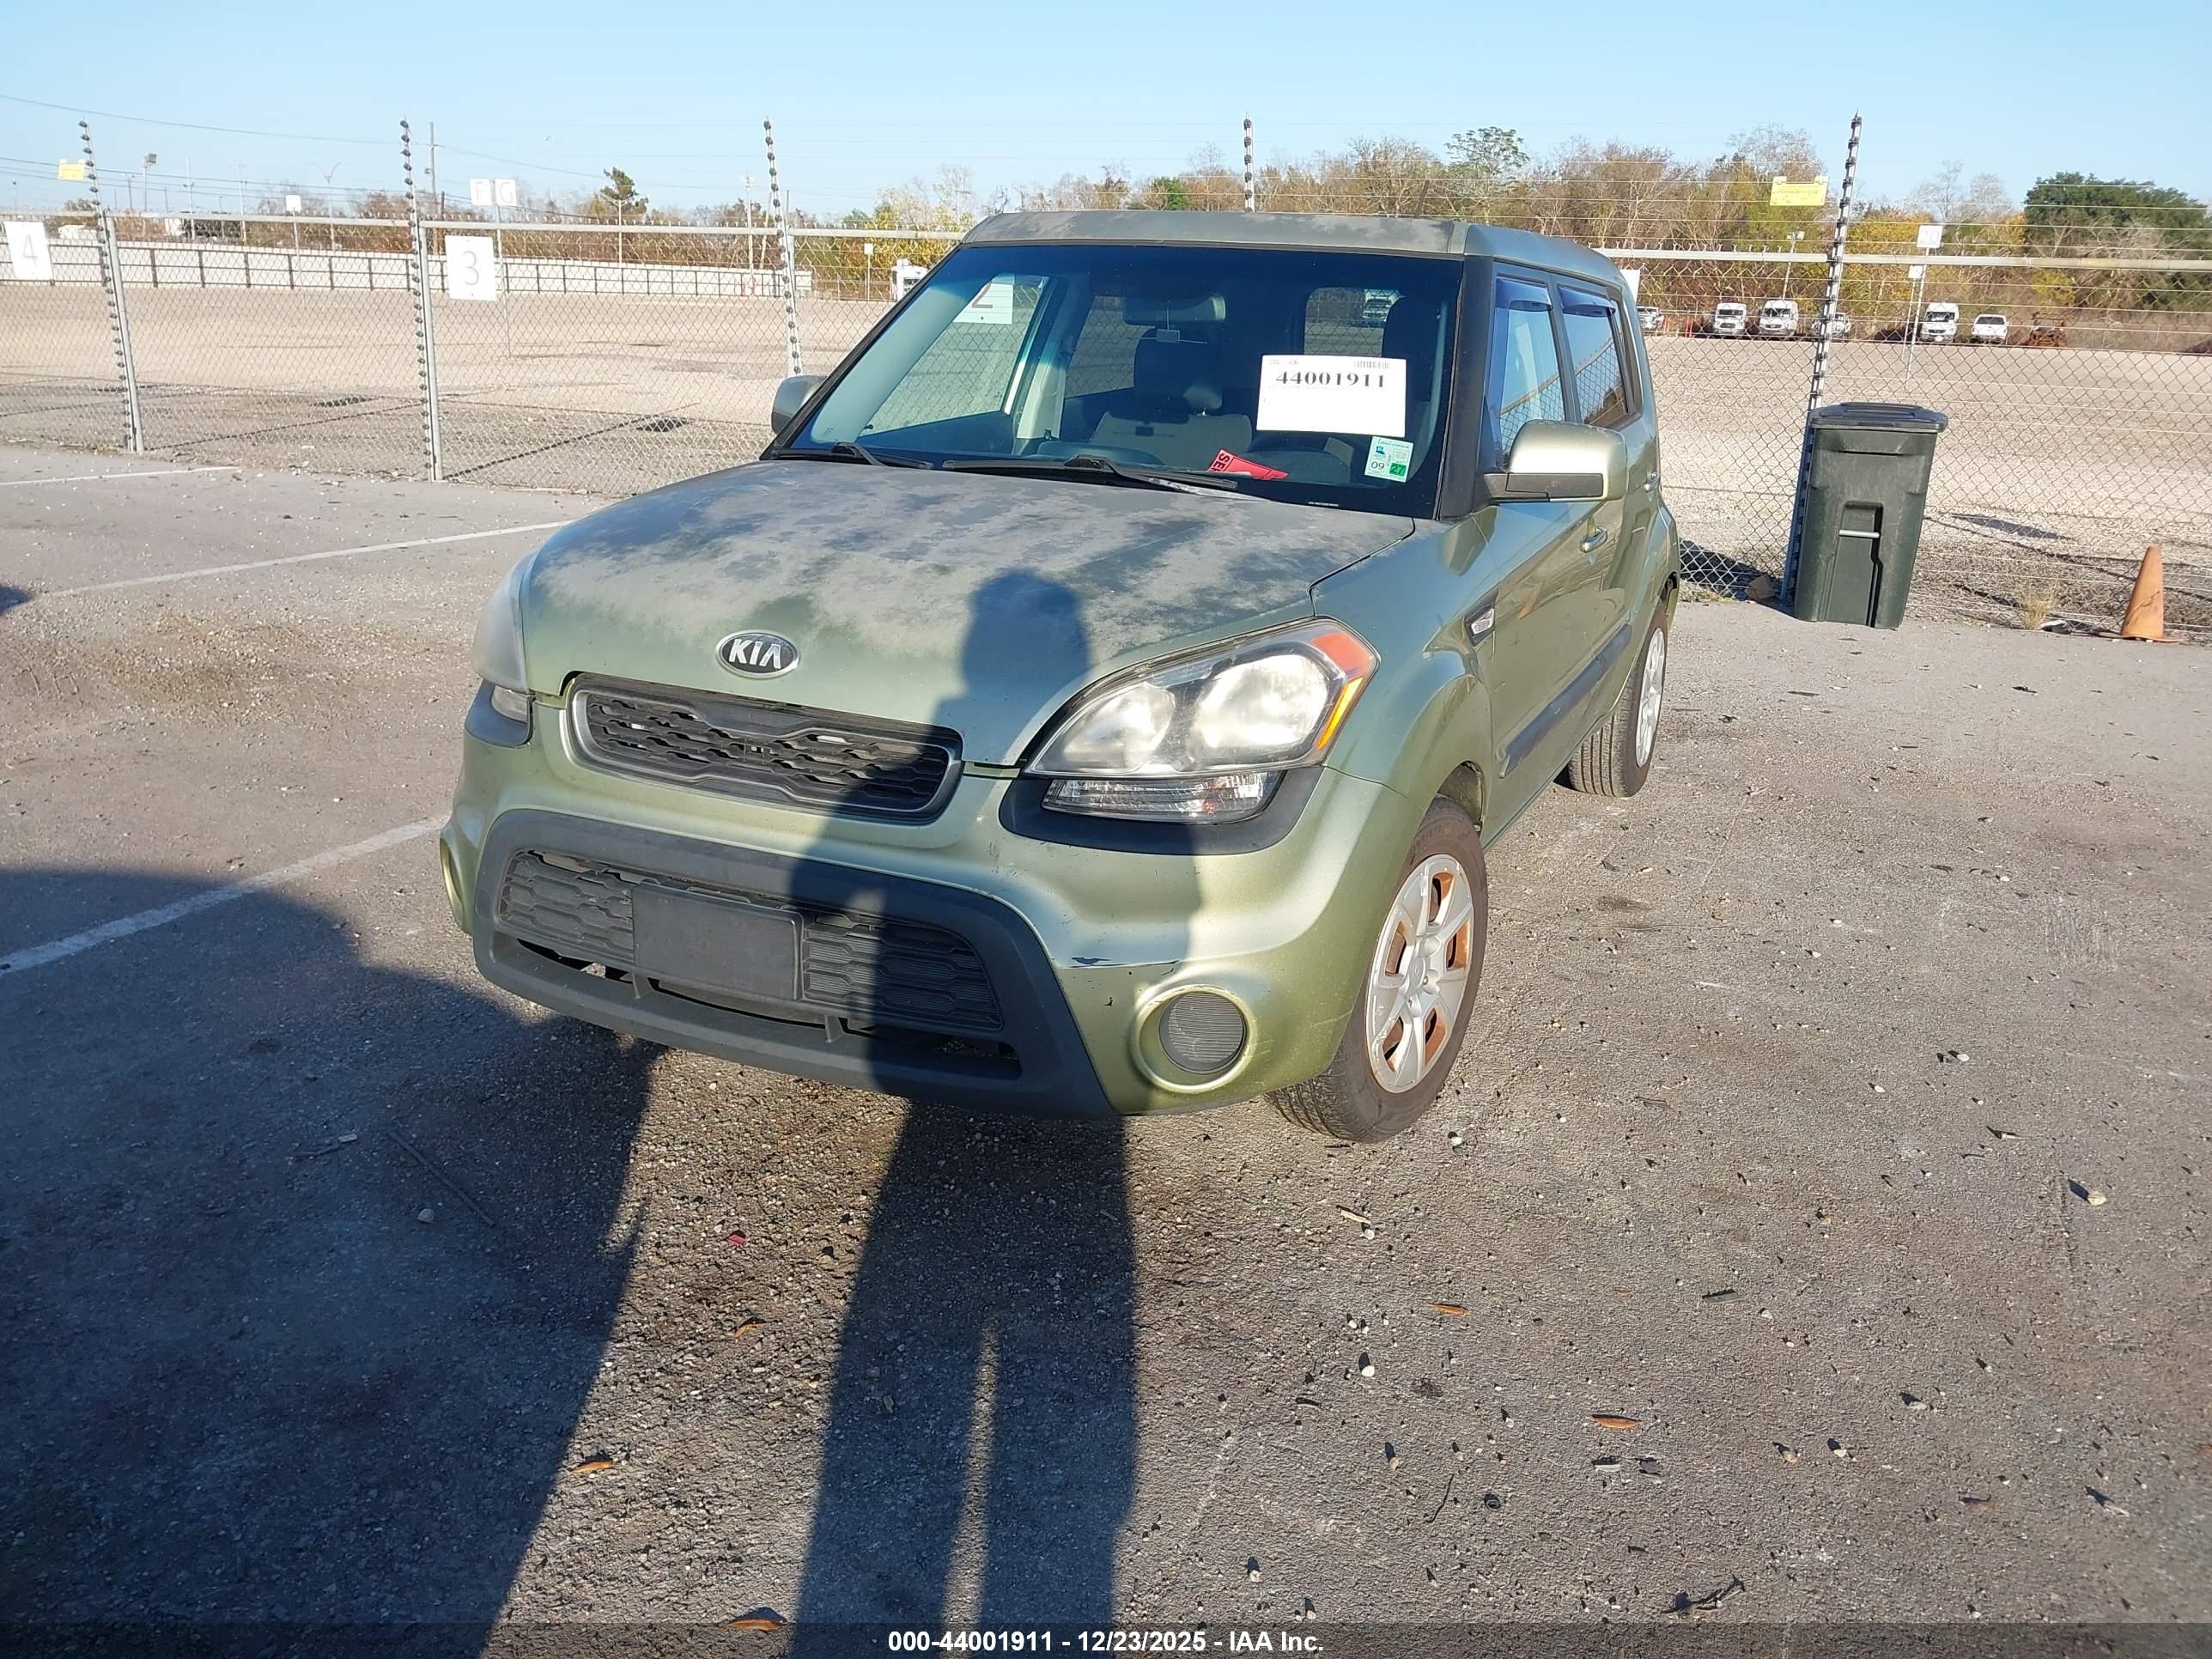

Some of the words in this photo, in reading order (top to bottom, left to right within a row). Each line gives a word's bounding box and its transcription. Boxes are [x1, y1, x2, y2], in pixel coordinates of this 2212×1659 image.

[500, 181, 514, 204] G
[23, 234, 37, 266] 4
[463, 251, 479, 286] 3
[1276, 371, 1383, 387] 44001911
[1370, 461, 1385, 470] 09
[1390, 463, 1405, 475] 27
[728, 638, 781, 670] KIA
